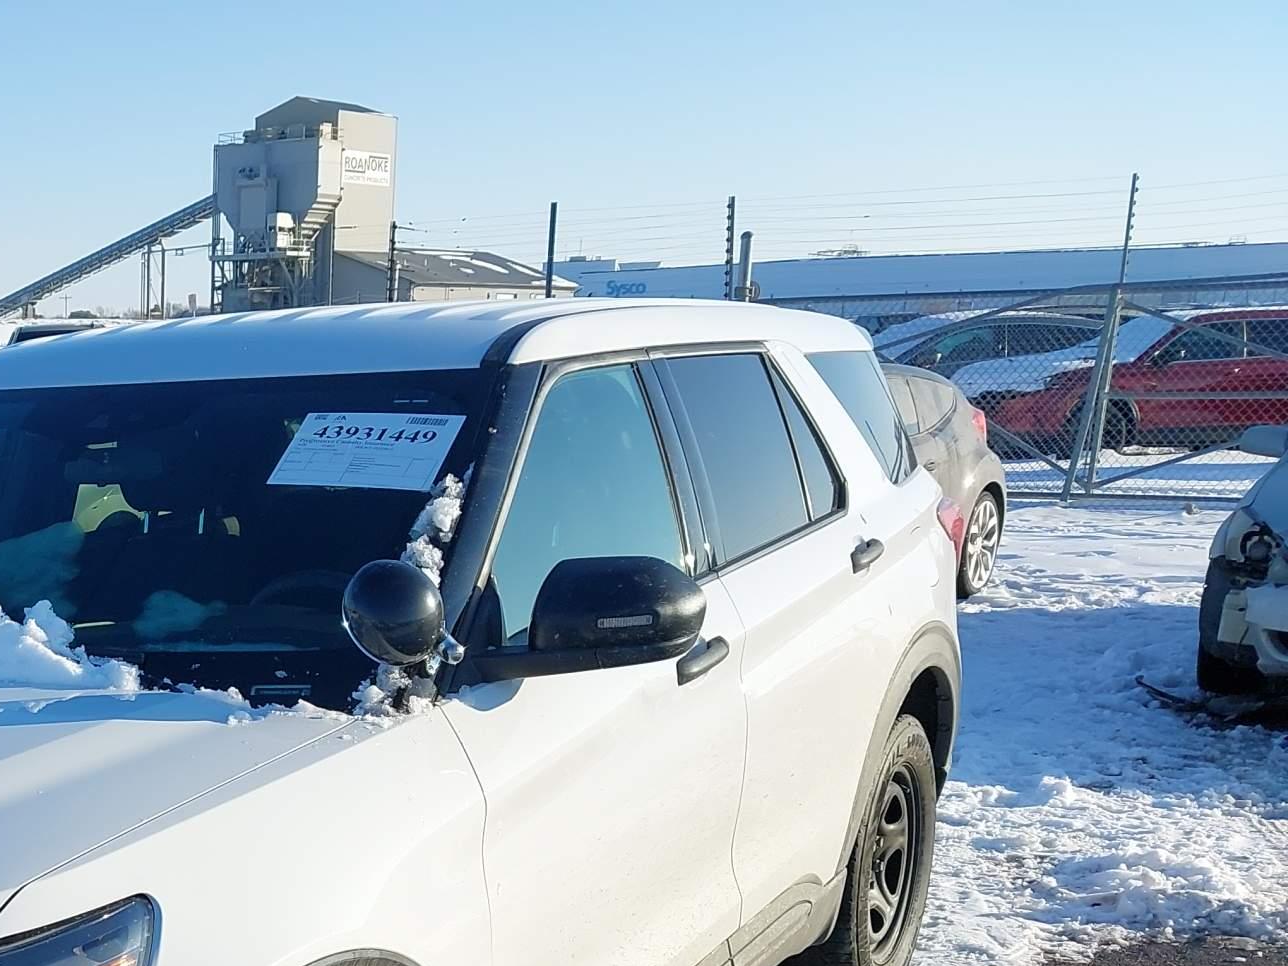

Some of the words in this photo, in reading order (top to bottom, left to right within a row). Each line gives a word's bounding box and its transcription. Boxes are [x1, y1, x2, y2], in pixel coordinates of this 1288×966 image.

[344, 156, 389, 173] ROANOKE
[606, 280, 647, 297] Sysco
[313, 425, 438, 444] 43931449
